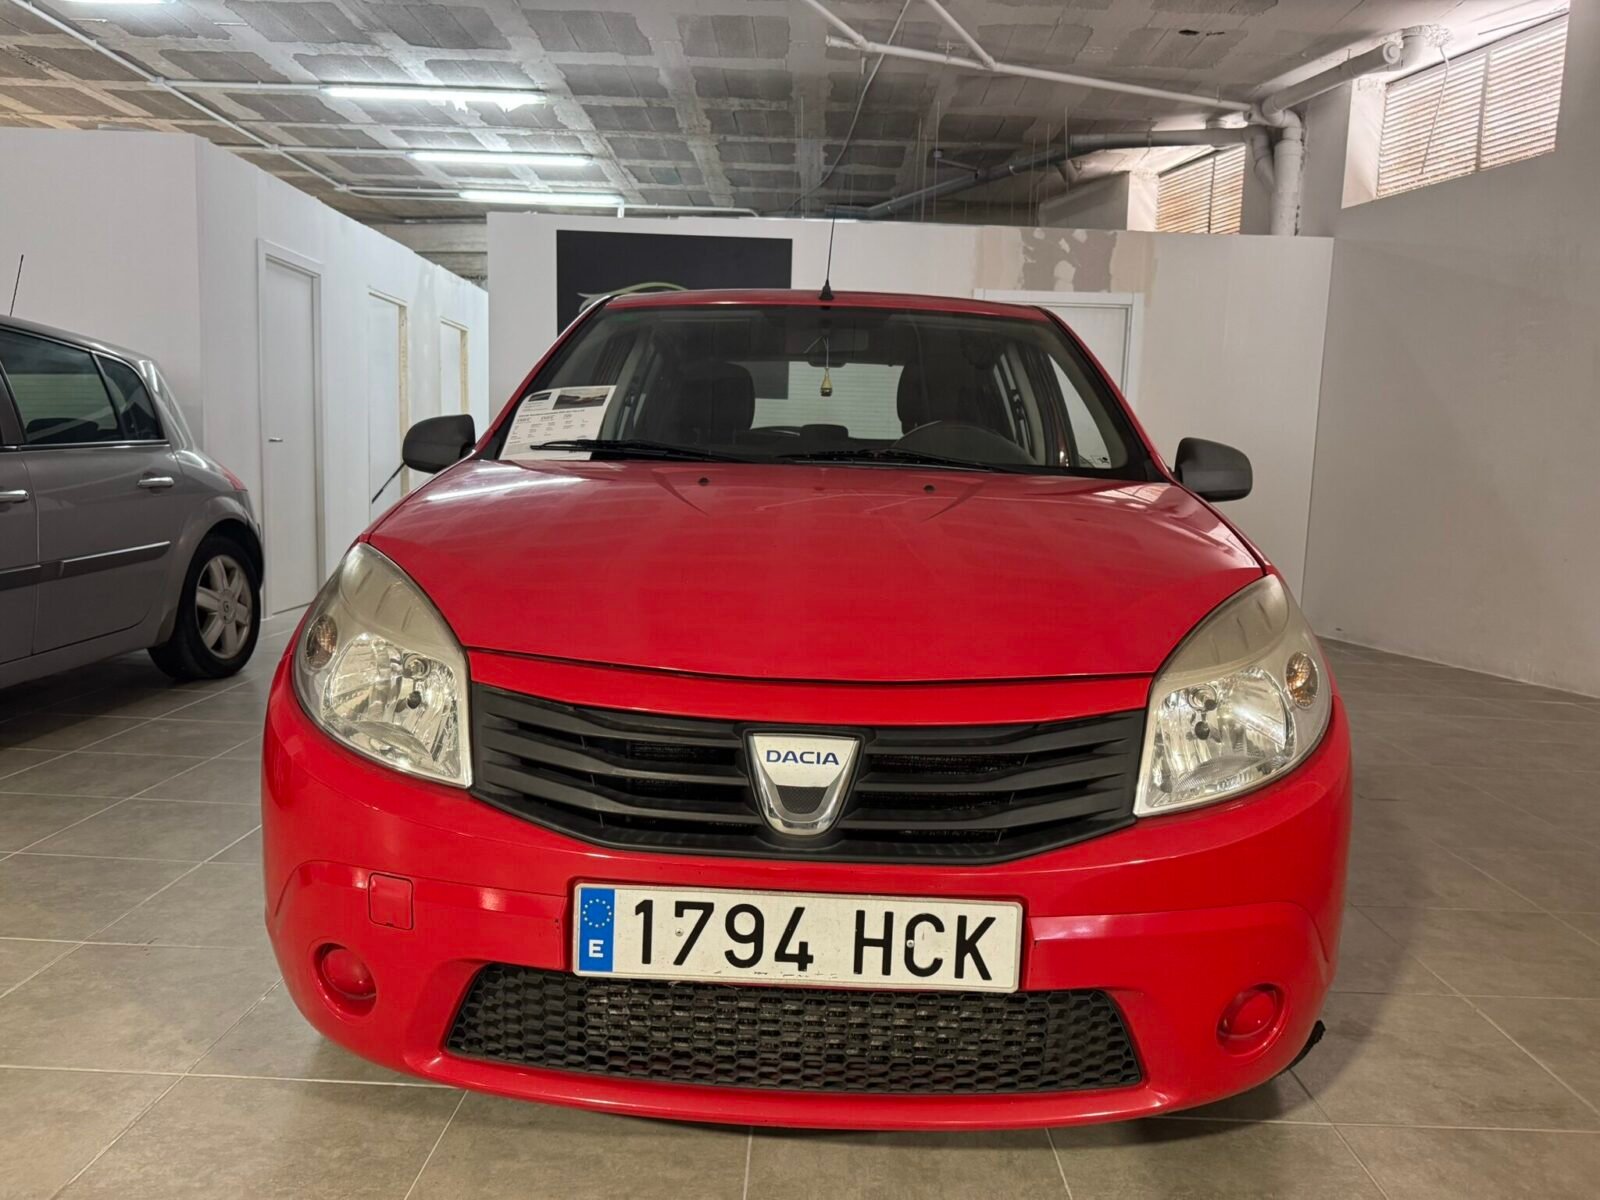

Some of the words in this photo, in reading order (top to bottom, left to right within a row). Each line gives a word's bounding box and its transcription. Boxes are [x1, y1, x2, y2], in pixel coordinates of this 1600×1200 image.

[766, 750, 839, 765] DACIA
[588, 939, 604, 958] E
[634, 899, 814, 972] 1794
[853, 909, 996, 981] HCK
